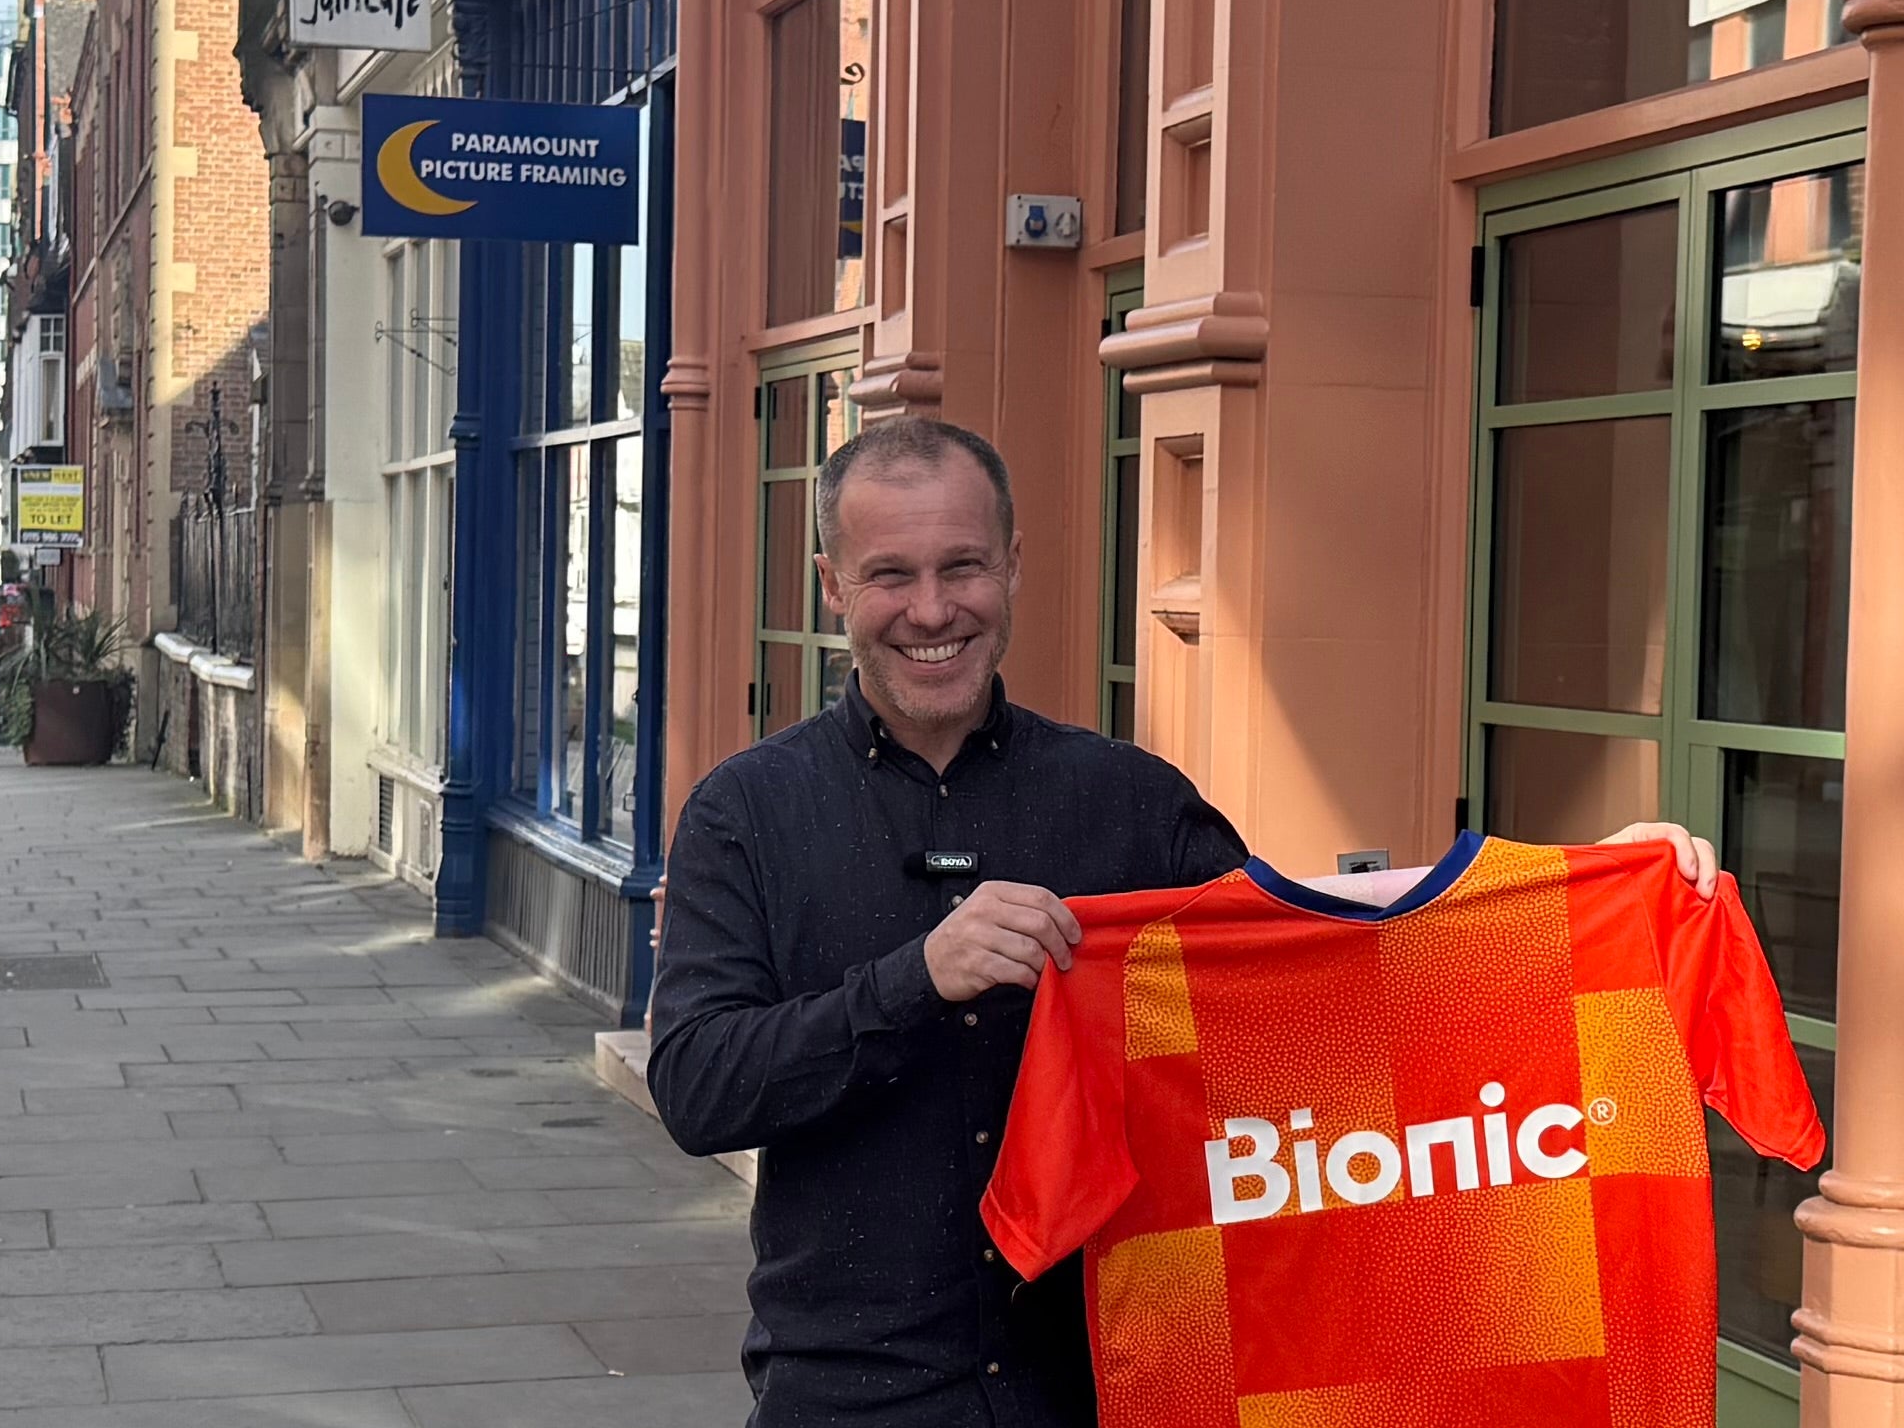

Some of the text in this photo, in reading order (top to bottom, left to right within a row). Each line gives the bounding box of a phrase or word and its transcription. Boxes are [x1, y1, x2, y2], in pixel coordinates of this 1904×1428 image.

[451, 133, 599, 158] PARAMOUNT
[420, 159, 627, 187] PICTURE FRAMING
[30, 514, 72, 525] TO LET
[941, 858, 968, 866] BOYA
